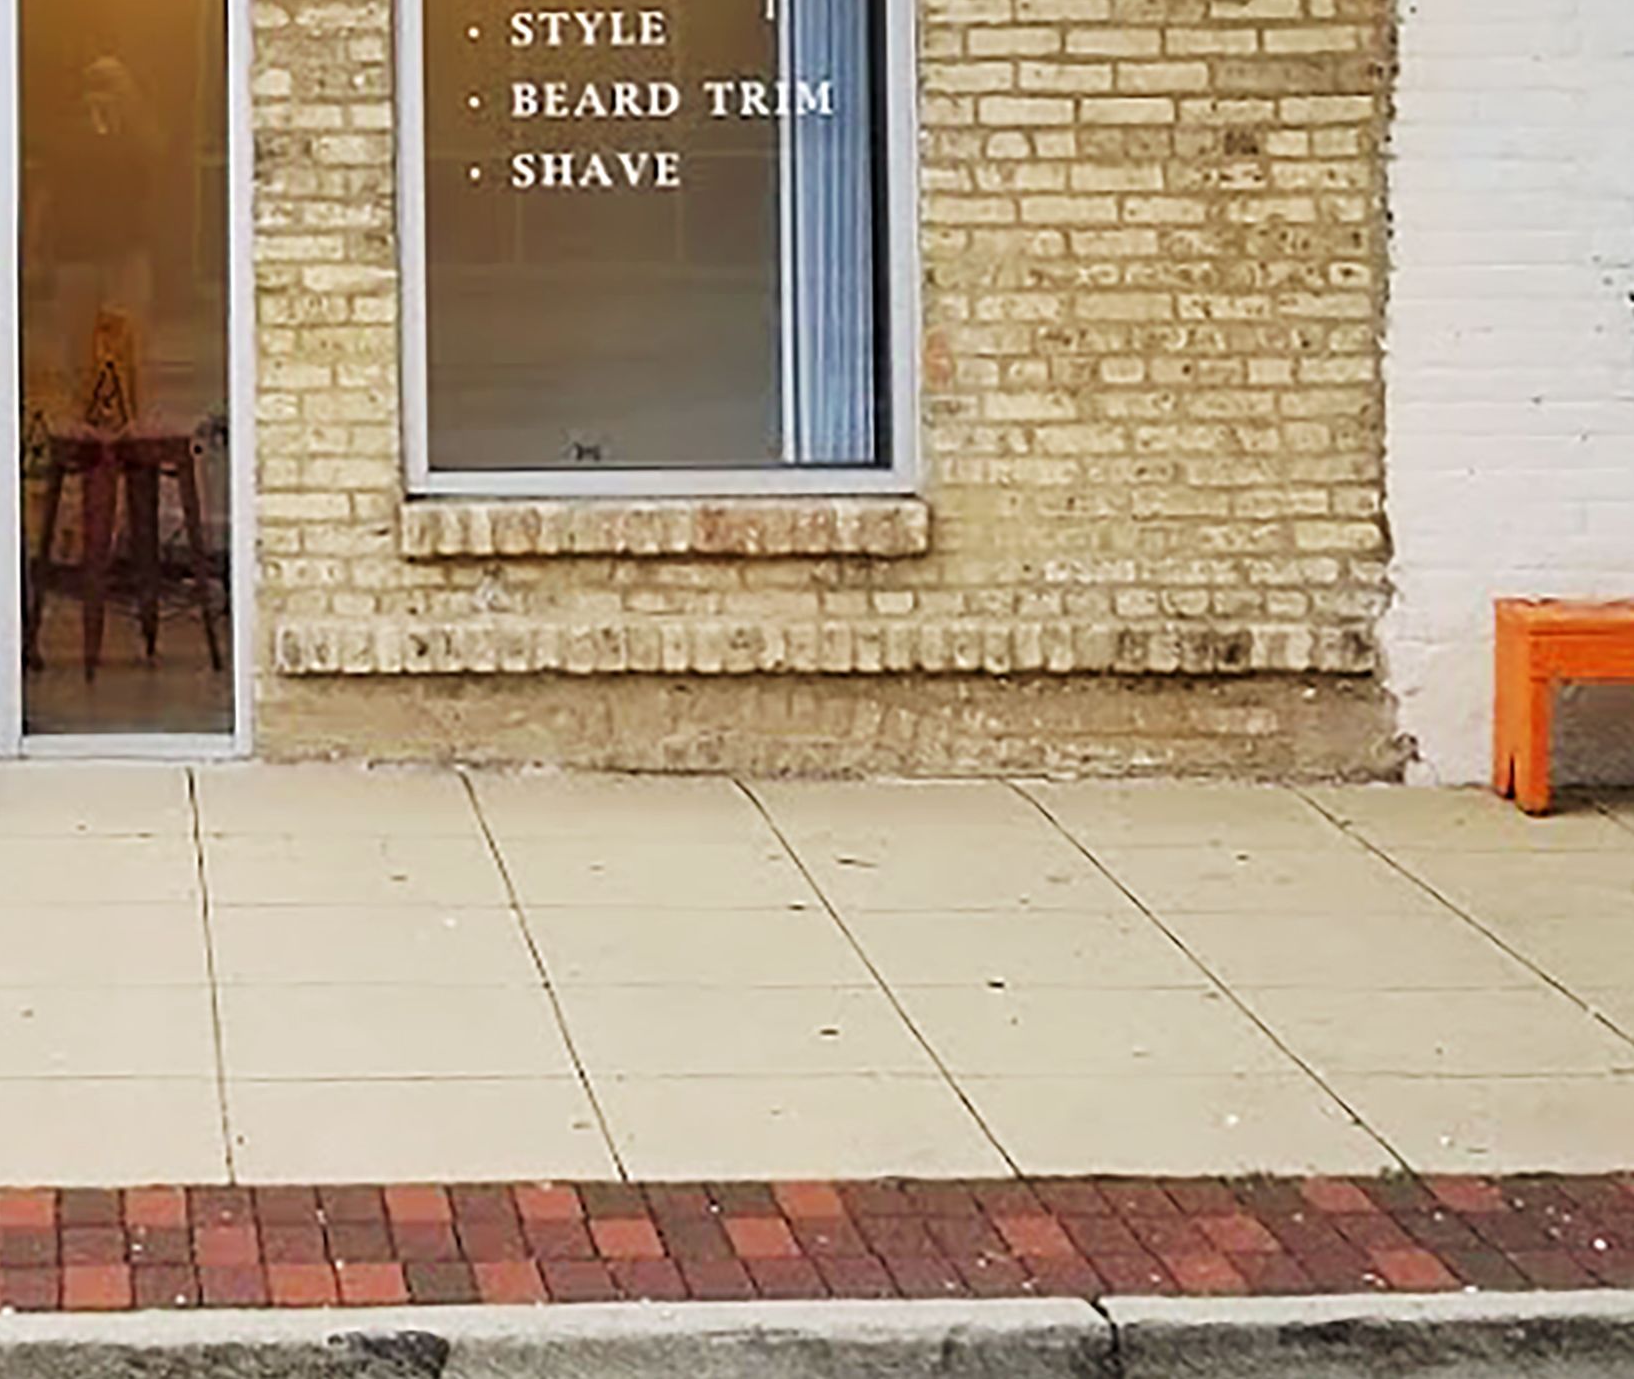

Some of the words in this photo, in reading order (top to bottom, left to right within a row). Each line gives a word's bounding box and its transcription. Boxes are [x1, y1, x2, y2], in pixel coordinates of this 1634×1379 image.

[510, 10, 667, 47] STYLE
[511, 81, 681, 118] BEARD
[703, 80, 834, 118] TRIM
[511, 151, 681, 188] SHAVE
